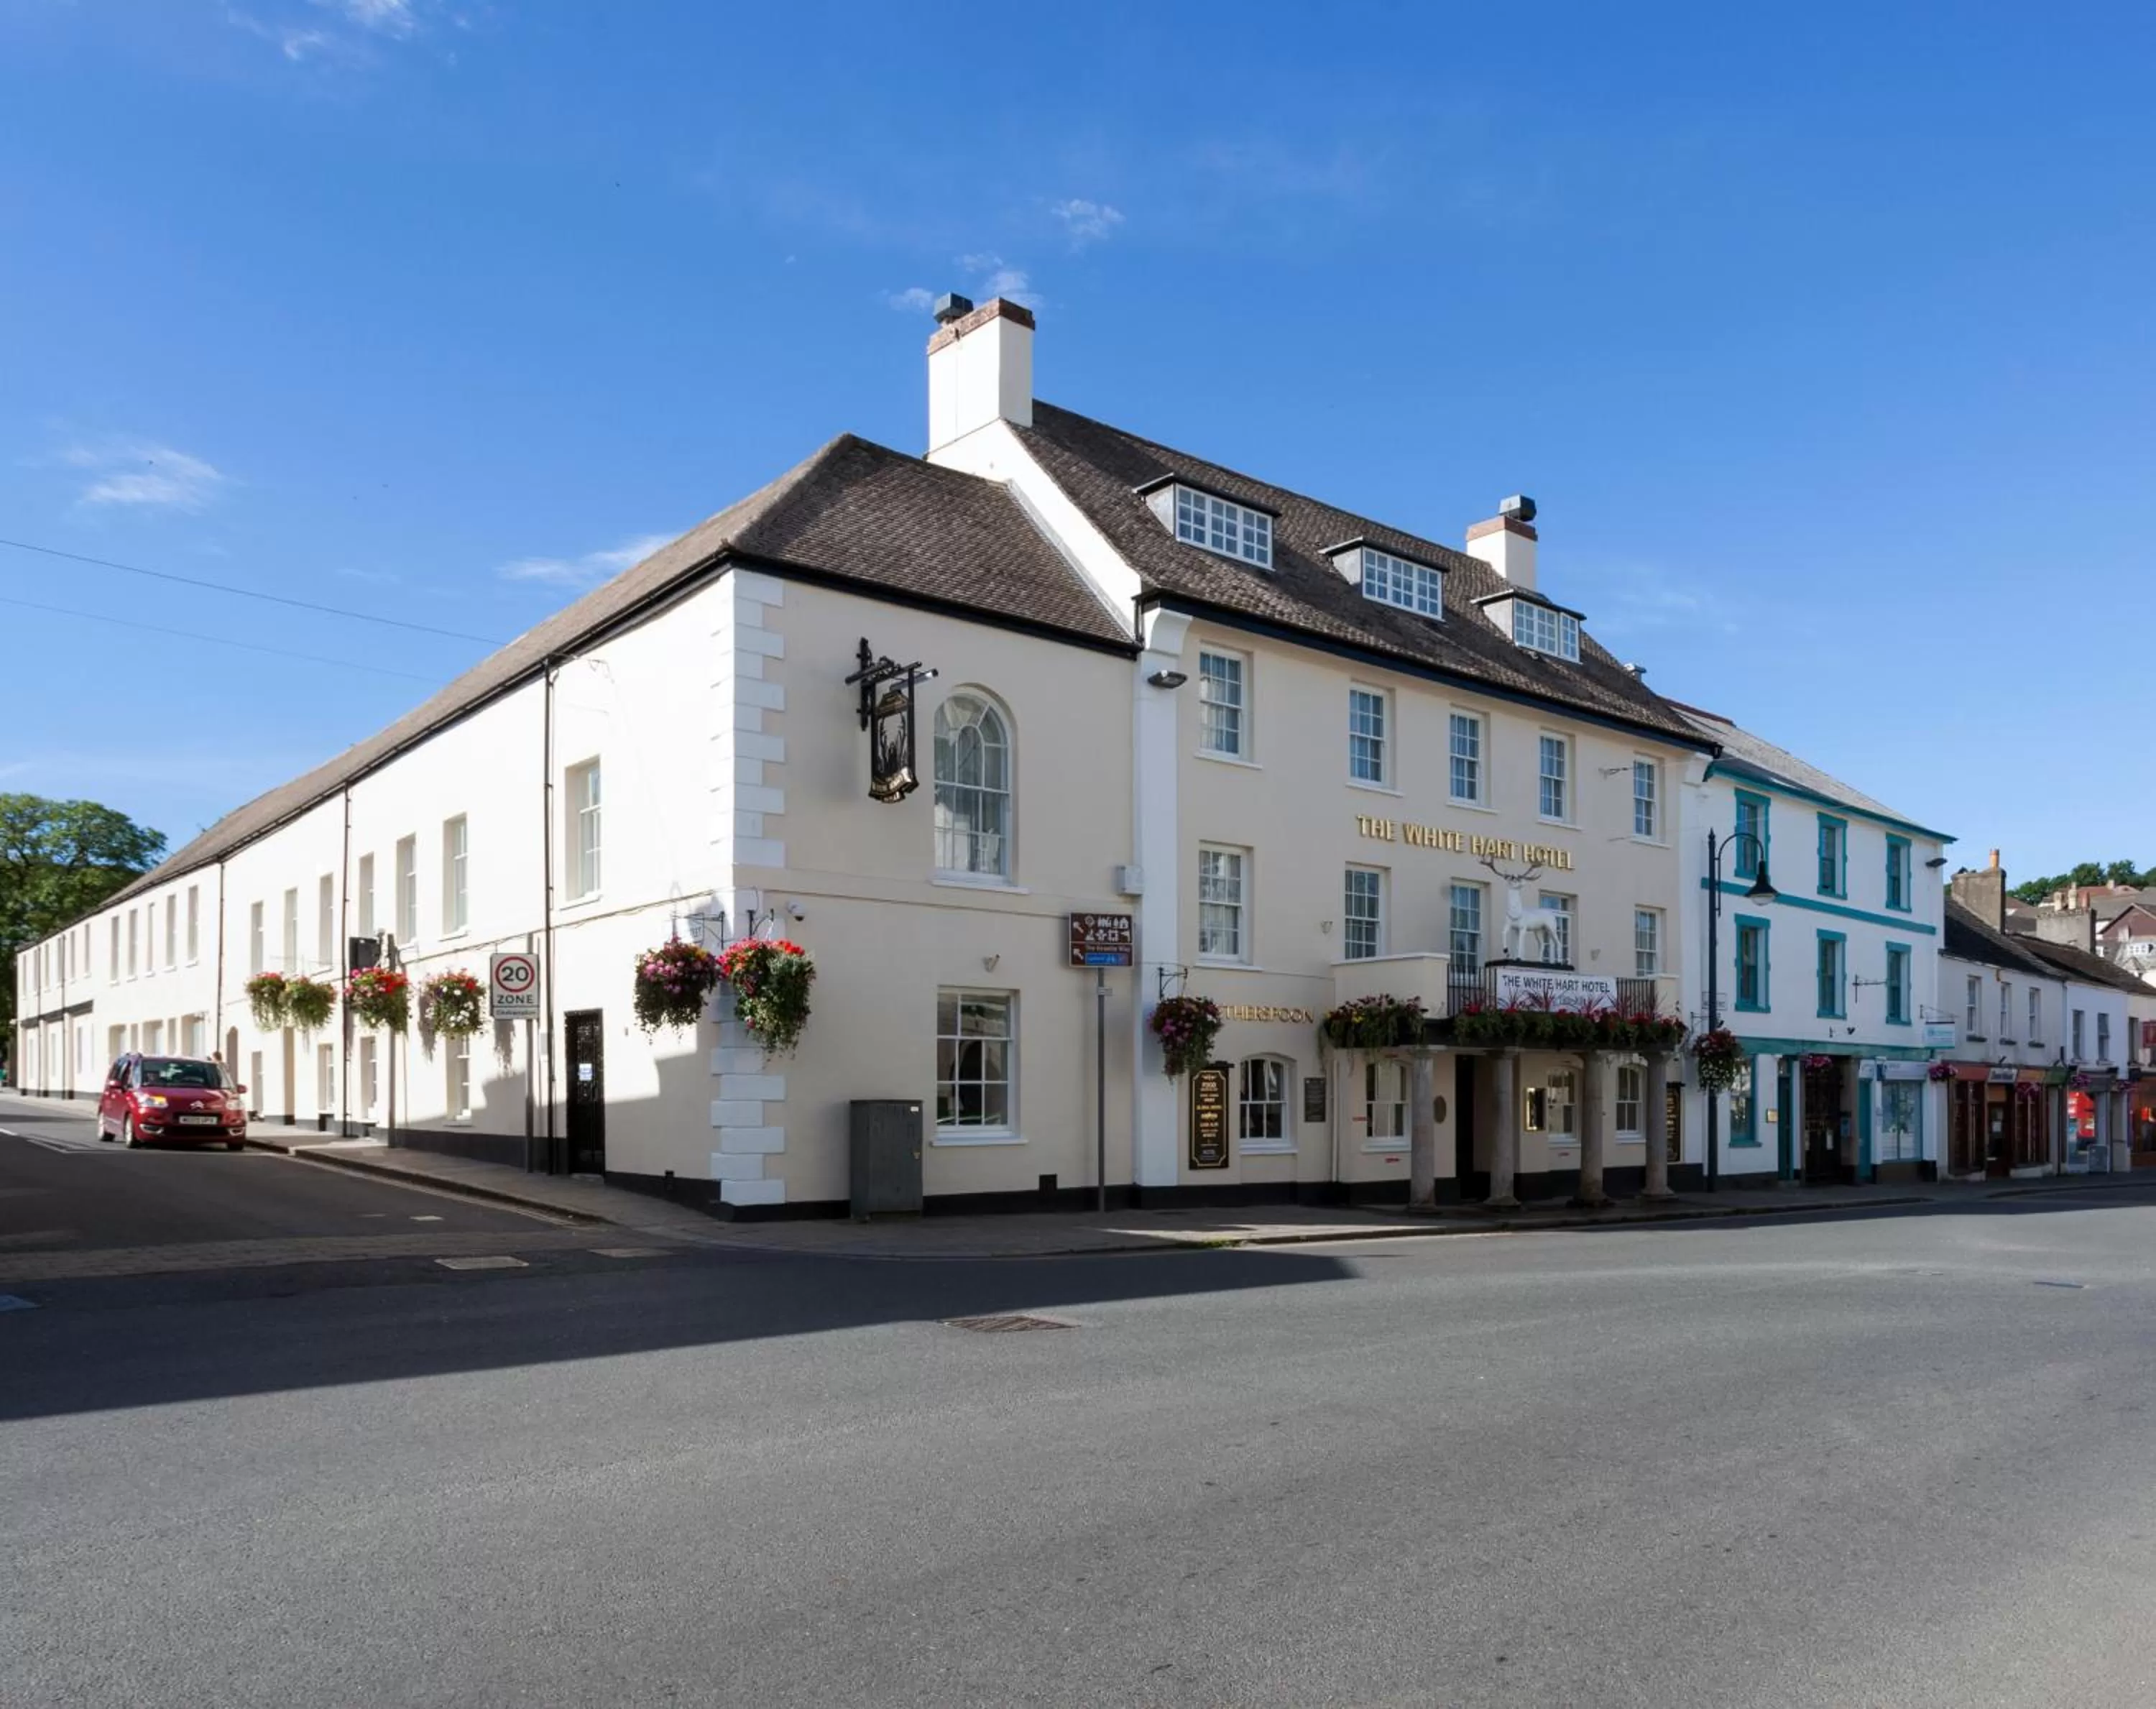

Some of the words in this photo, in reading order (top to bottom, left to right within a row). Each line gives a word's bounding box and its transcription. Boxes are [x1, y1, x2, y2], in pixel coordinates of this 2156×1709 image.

[1357, 816, 1398, 842] THE
[1402, 822, 1465, 853] WHITE
[1470, 834, 1518, 861] HART
[1522, 843, 1575, 870] HOTEL
[502, 966, 529, 982] 20
[1502, 975, 1521, 987] THE
[1523, 976, 1554, 990] WHITE
[1555, 978, 1579, 992] HART
[1581, 980, 1611, 993] HOTEL
[497, 994, 535, 1004] ZONE
[1223, 1005, 1314, 1023] THERSPOON
